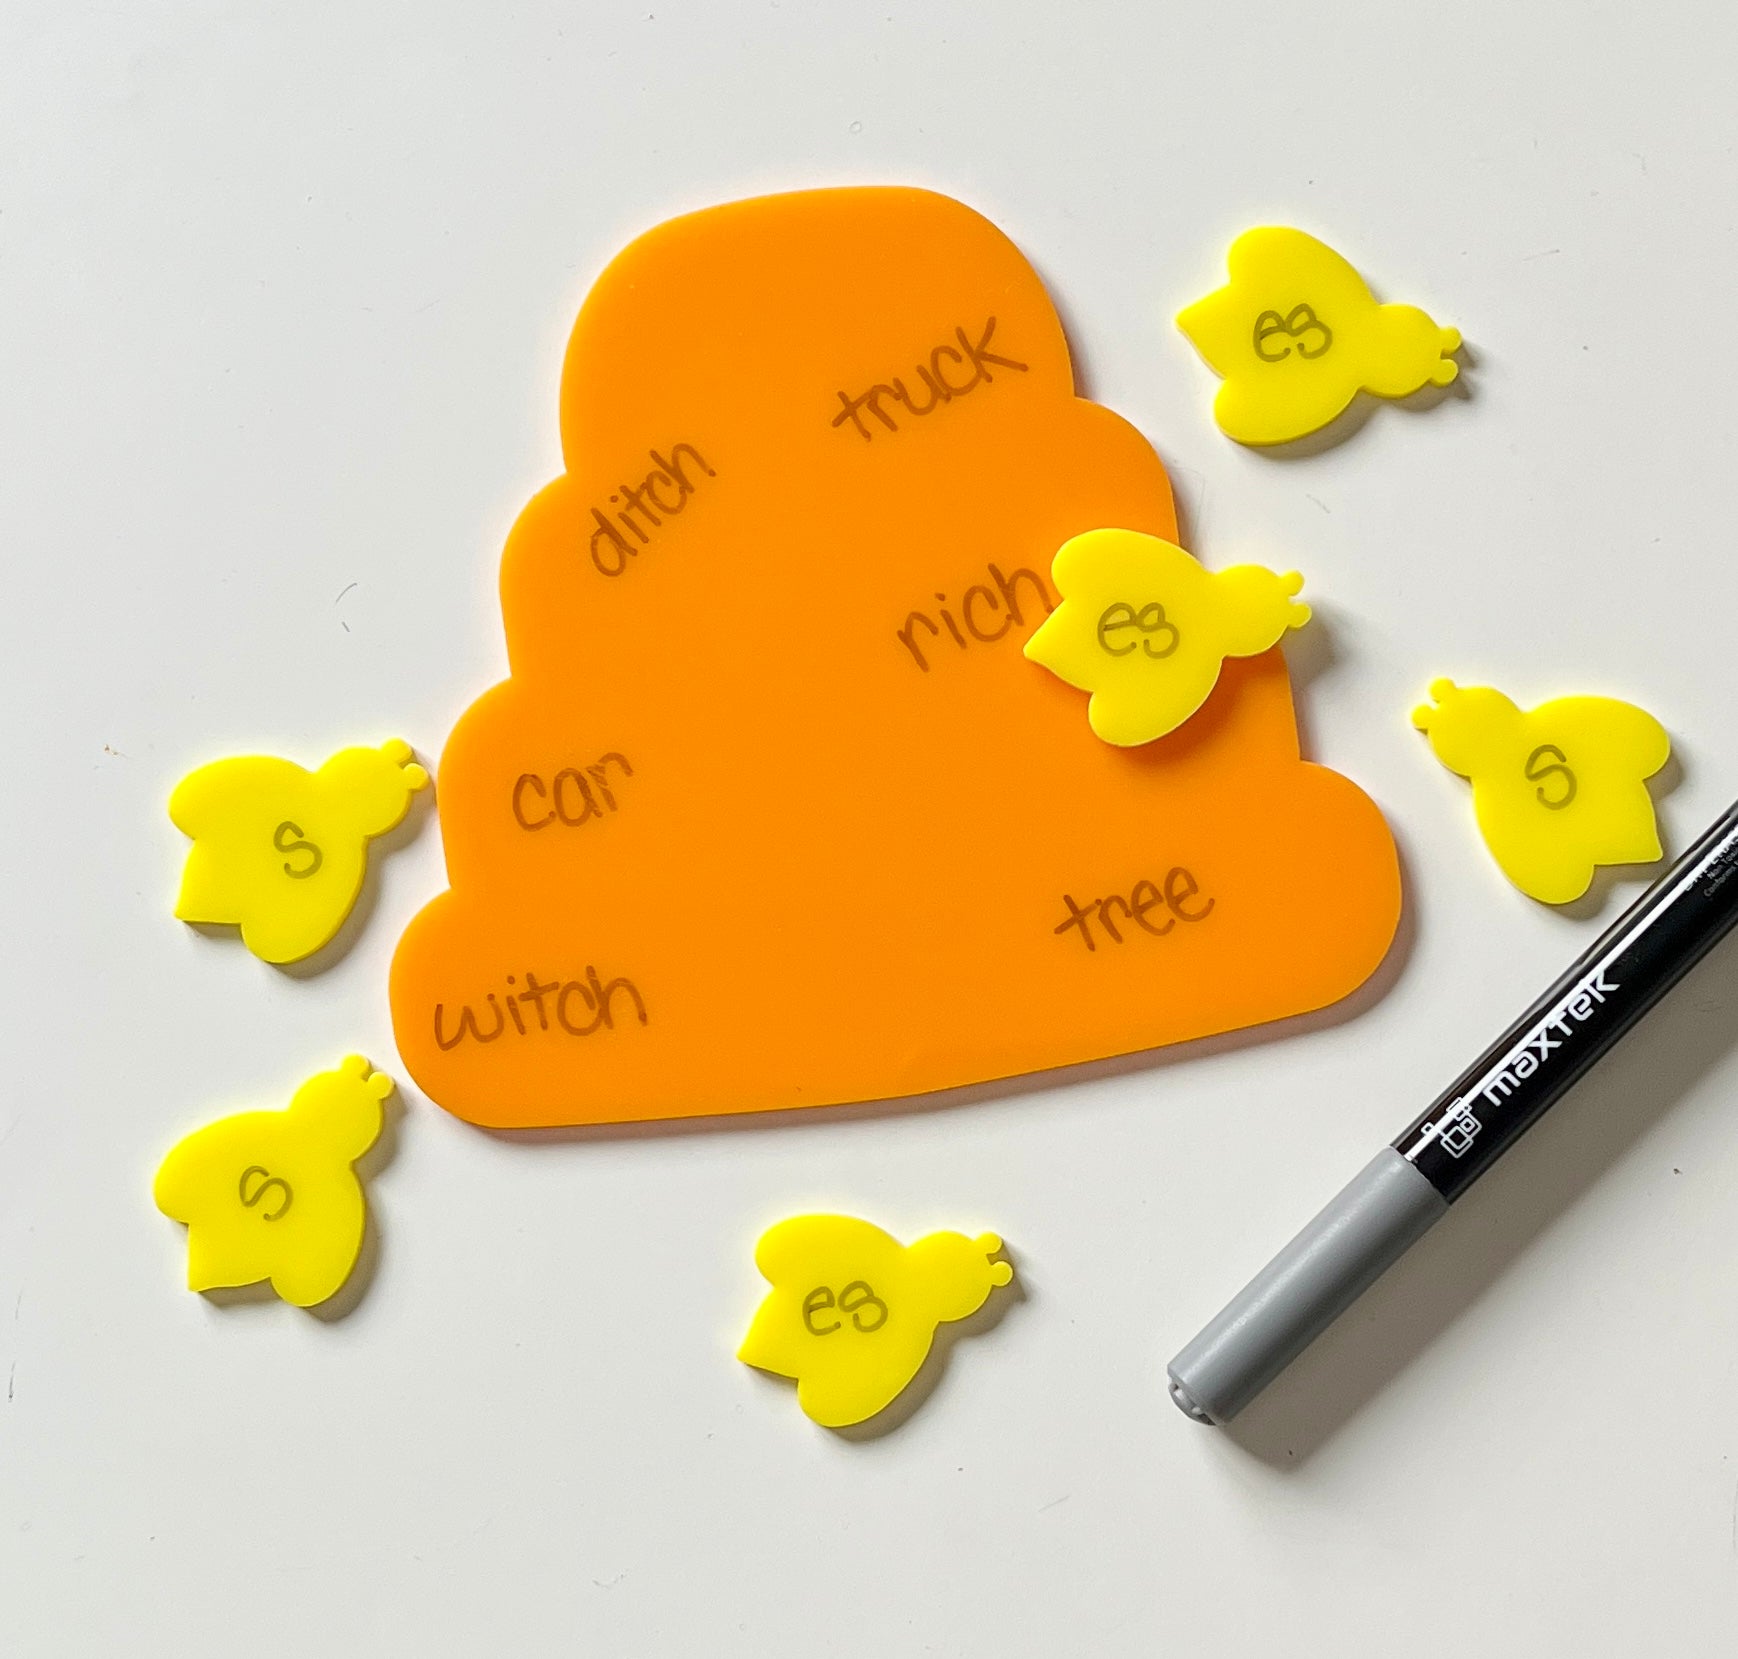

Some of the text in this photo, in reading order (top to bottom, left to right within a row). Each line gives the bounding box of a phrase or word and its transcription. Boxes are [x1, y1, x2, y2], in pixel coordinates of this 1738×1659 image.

[832, 317, 1029, 442] truck
[589, 442, 717, 578] ditch
[897, 563, 1052, 674] rich
[512, 752, 634, 832] car
[1054, 865, 1216, 953] tree
[434, 966, 647, 1051] witch
